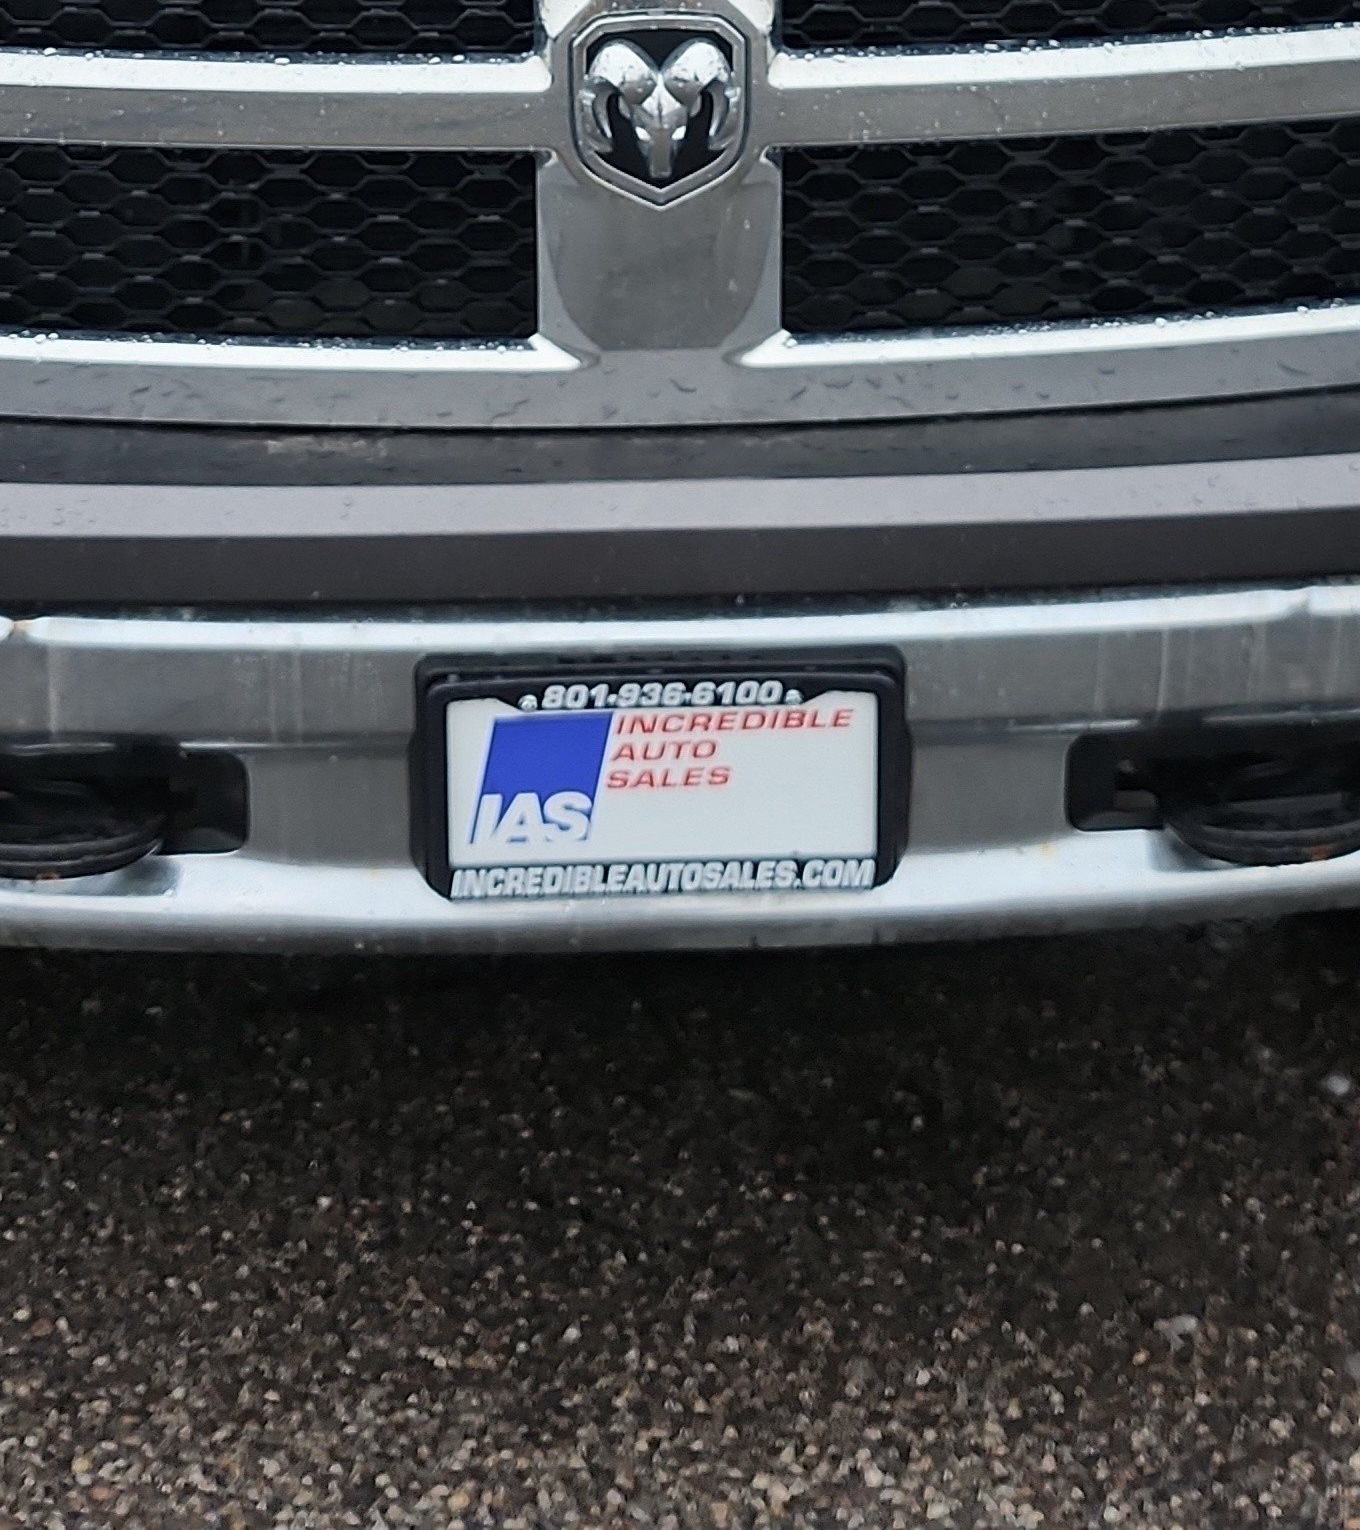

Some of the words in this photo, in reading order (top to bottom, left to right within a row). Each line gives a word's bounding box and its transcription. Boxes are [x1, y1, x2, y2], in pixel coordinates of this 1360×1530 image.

[616, 709, 855, 735] INCREDIBLE
[612, 740, 717, 761] AUTO
[606, 766, 732, 789] SALES
[472, 791, 593, 844] IAS
[450, 859, 876, 899] INCREDIBLEAUTOSALES.COM
